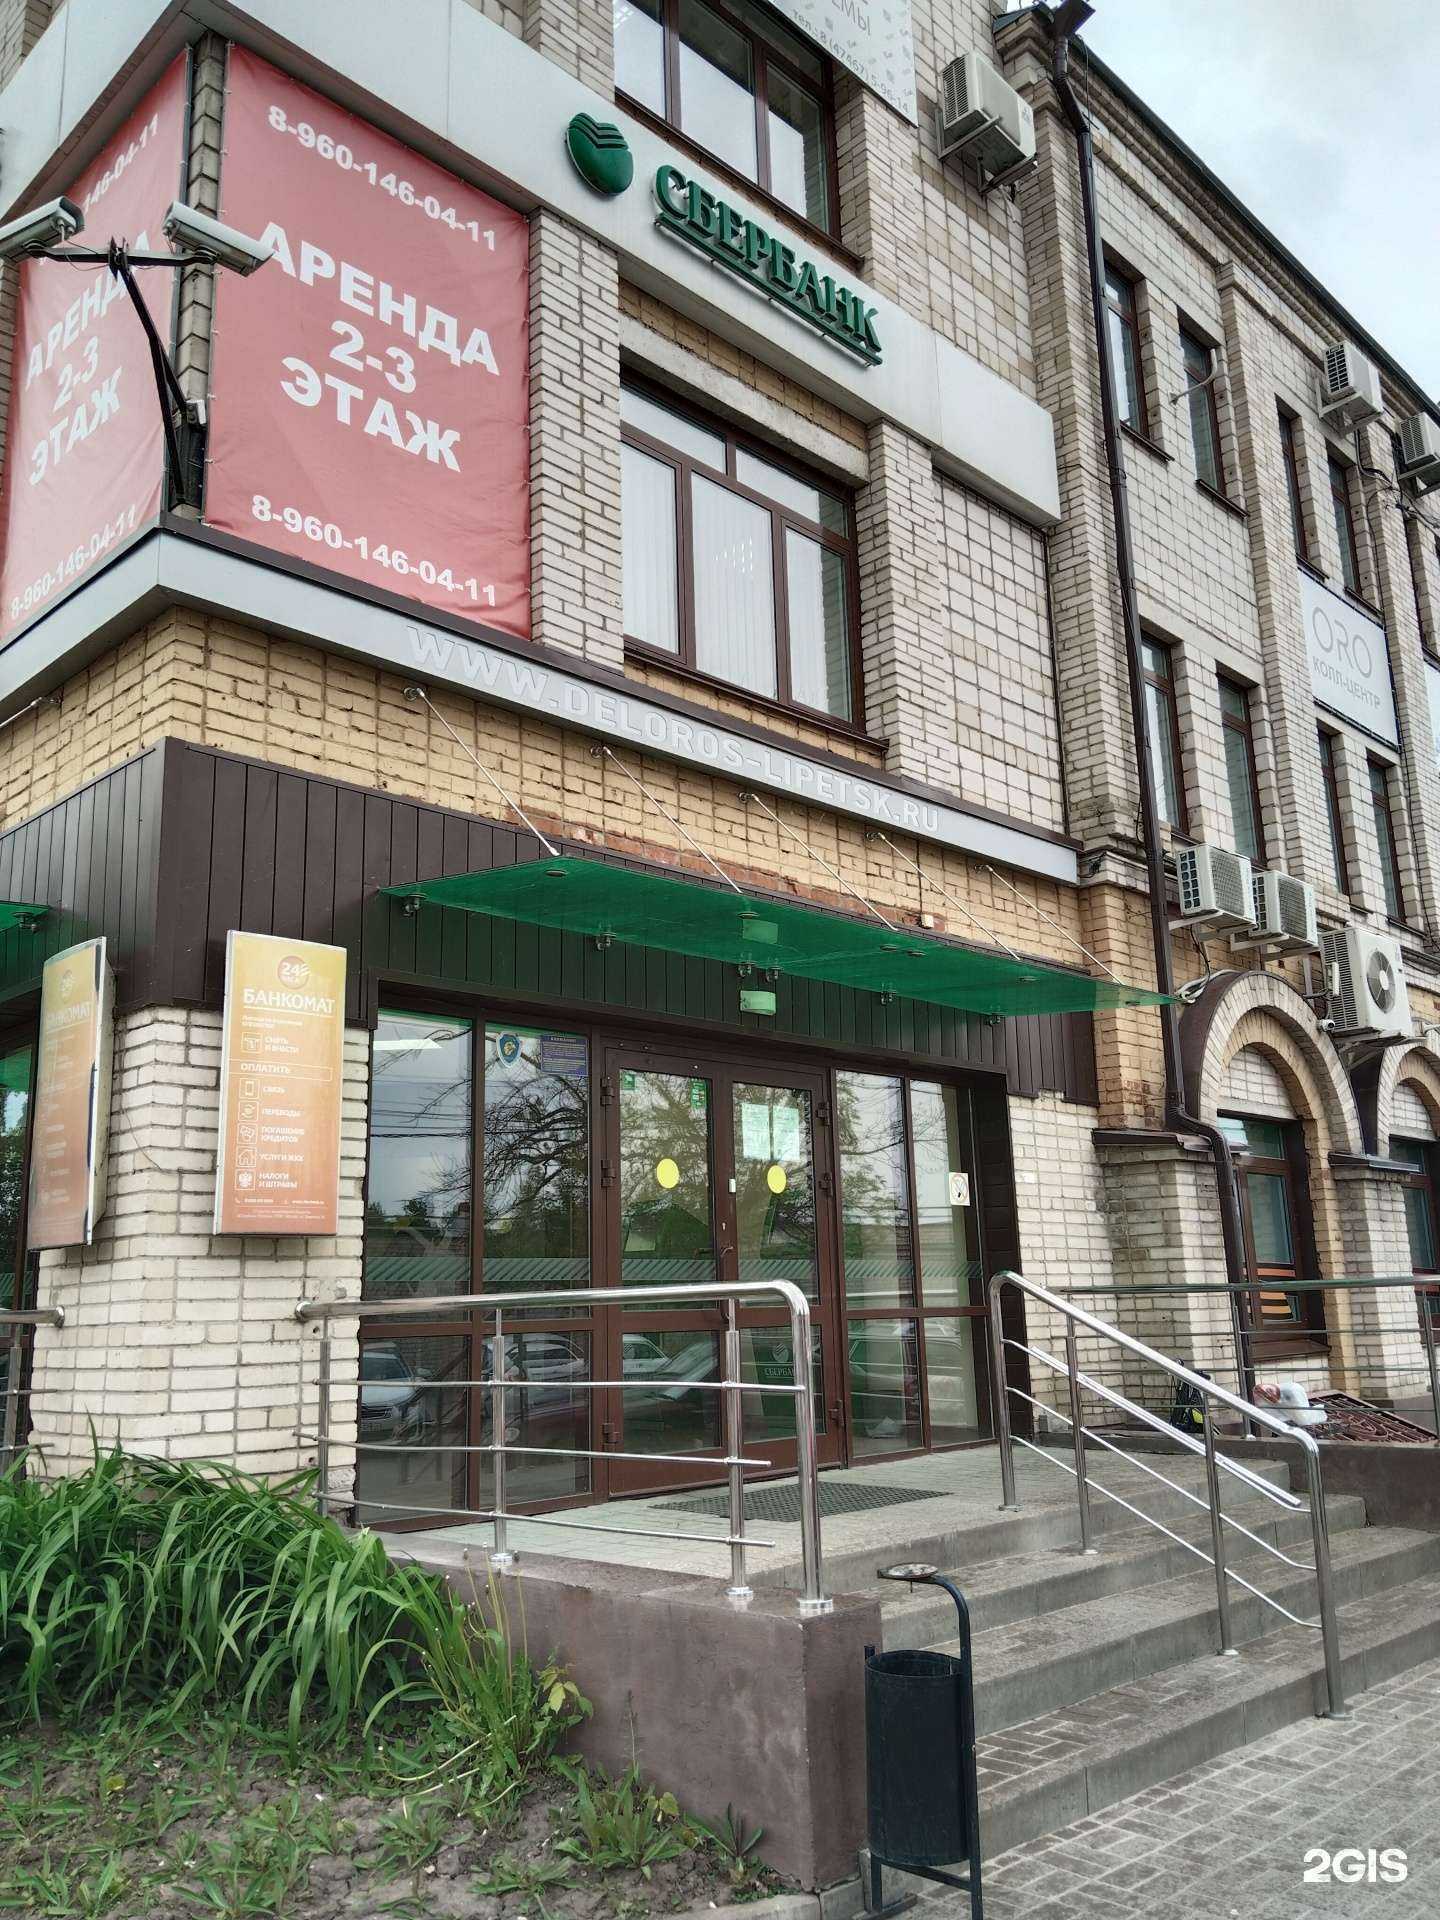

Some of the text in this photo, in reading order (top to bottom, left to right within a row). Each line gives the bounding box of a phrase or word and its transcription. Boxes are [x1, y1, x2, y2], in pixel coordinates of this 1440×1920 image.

[832, 0, 871, 36] МЫ
[268, 105, 497, 252] 8-960-146-04-11
[259, 221, 501, 377] АРЕНДА
[654, 164, 883, 354] СБЕРБАНК
[52, 335, 99, 414] 2-3
[330, 320, 417, 394] 2-3
[28, 366, 123, 487] ЭТАЖ
[280, 357, 462, 473] ЭТАЖ
[9, 503, 137, 620] 8-960-146-04-11
[251, 495, 498, 608] 8-960-146-04-11
[1312, 606, 1373, 679] ORO
[243, 988, 336, 1014] БАНКОМАТ
[240, 1063, 291, 1074] ОПЛАТИТЬ
